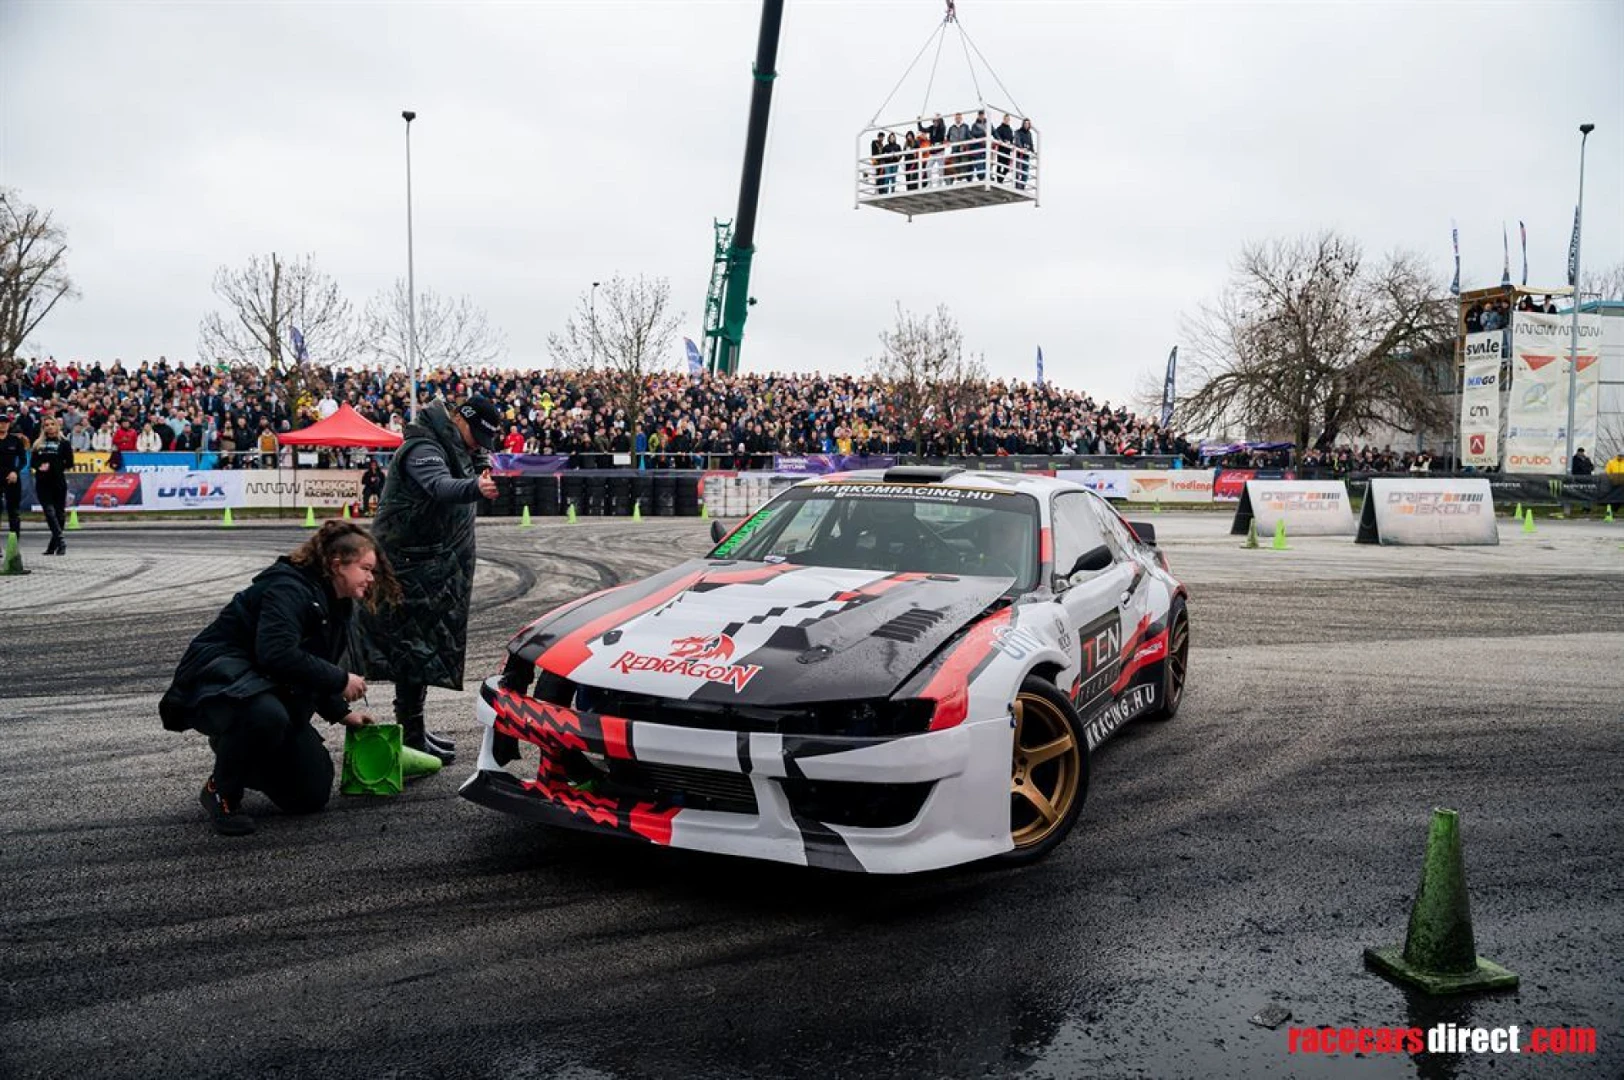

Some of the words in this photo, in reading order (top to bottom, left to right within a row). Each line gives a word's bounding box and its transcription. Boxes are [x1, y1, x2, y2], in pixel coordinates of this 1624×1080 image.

[1466, 338, 1500, 355] svale
[1510, 455, 1552, 465] aruba
[157, 482, 225, 498] UNIX
[304, 480, 357, 490] MARKOM
[812, 484, 995, 501] MARKOMRACING.HU
[304, 490, 335, 498] RACING
[337, 490, 358, 498] TEAM
[1387, 492, 1443, 503] DRIFT
[1083, 622, 1120, 673] TEN
[610, 651, 763, 694] REDRAGON
